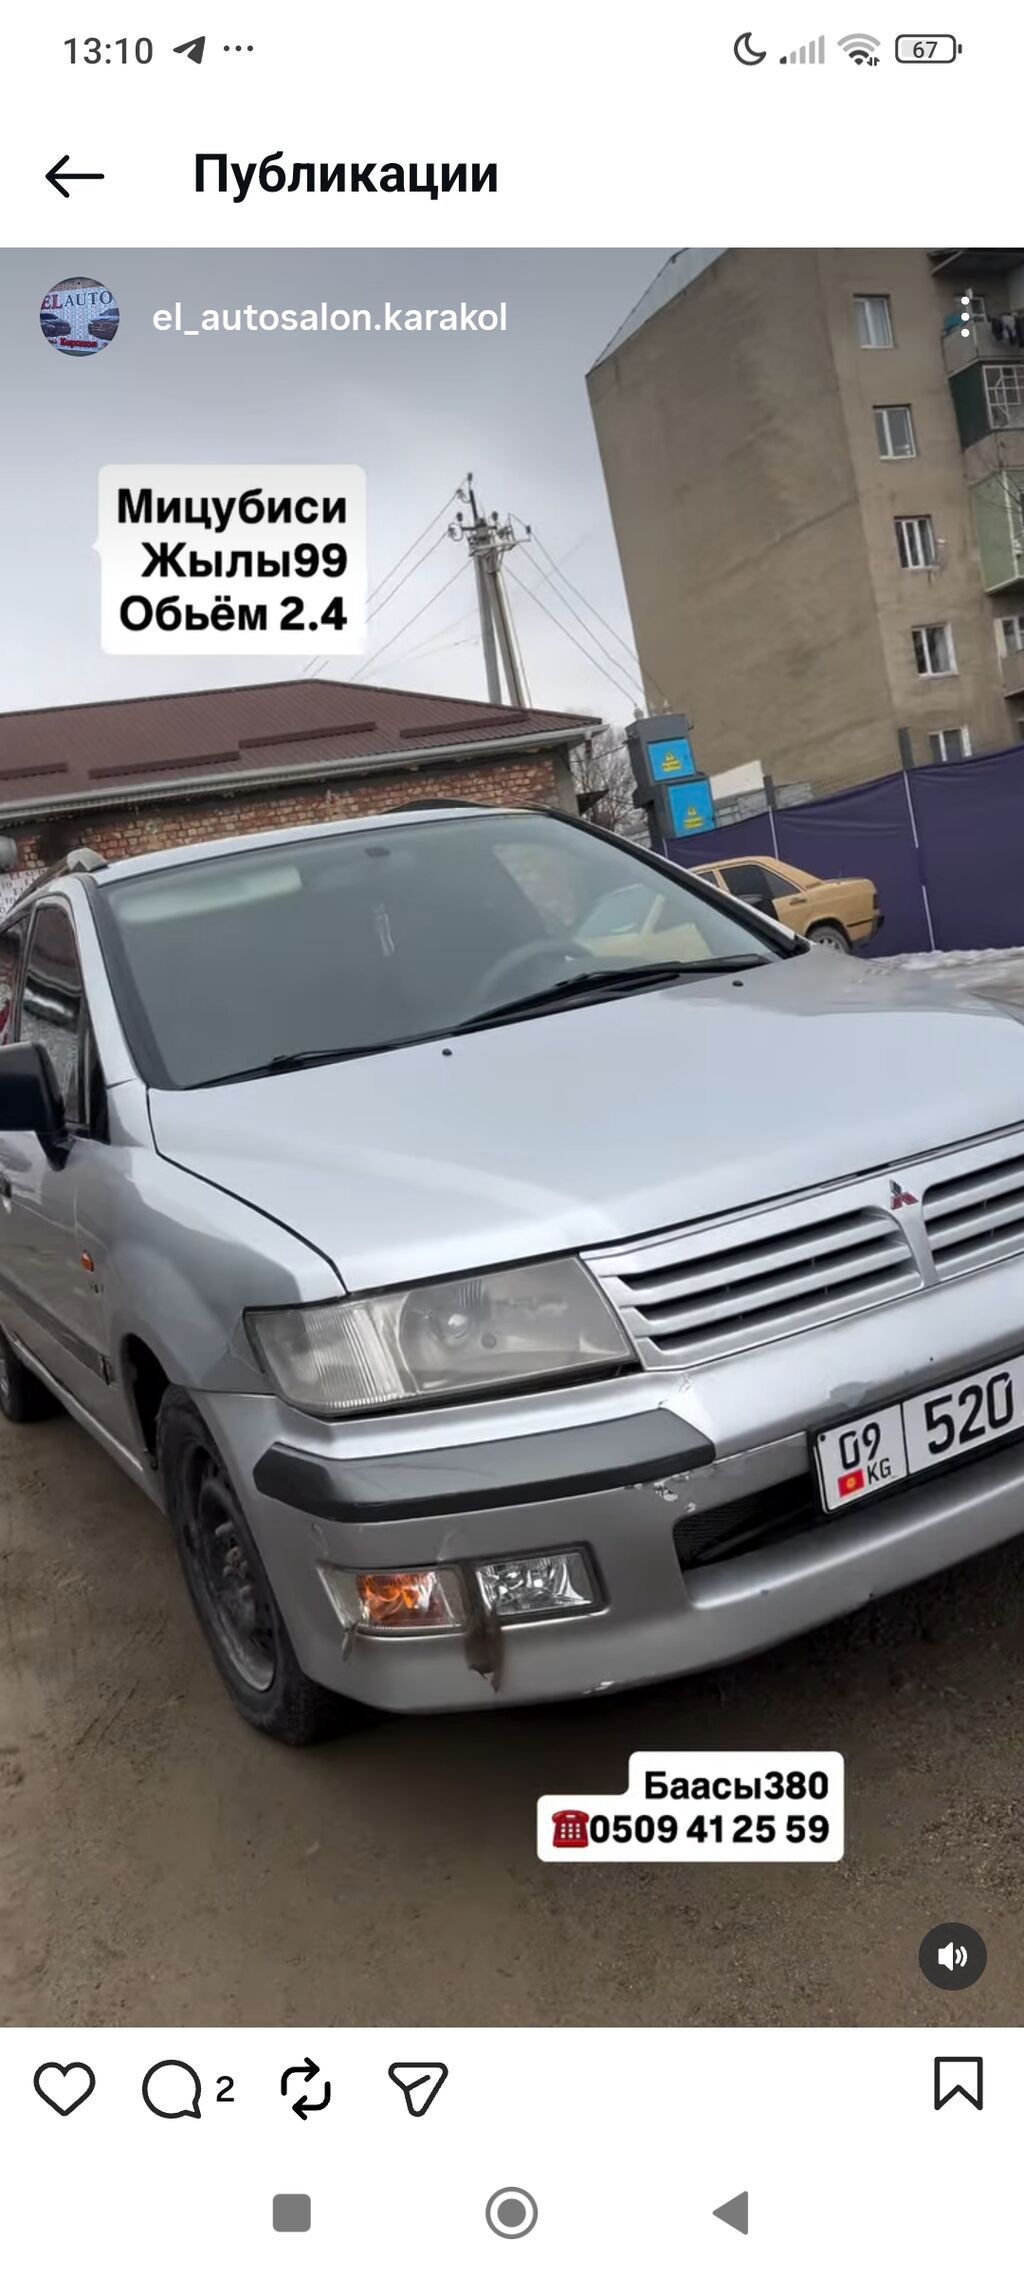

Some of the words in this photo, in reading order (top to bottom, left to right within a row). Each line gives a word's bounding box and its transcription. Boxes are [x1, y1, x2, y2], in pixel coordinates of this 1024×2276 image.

[64, 37, 153, 65] 13:10
[913, 41, 938, 59] 67
[195, 150, 497, 204] Публикации
[65, 290, 113, 307] AUTO
[838, 1421, 881, 1470] 09
[924, 1371, 1014, 1455] 520
[867, 1457, 892, 1485] KG
[216, 2075, 235, 2103] 2
